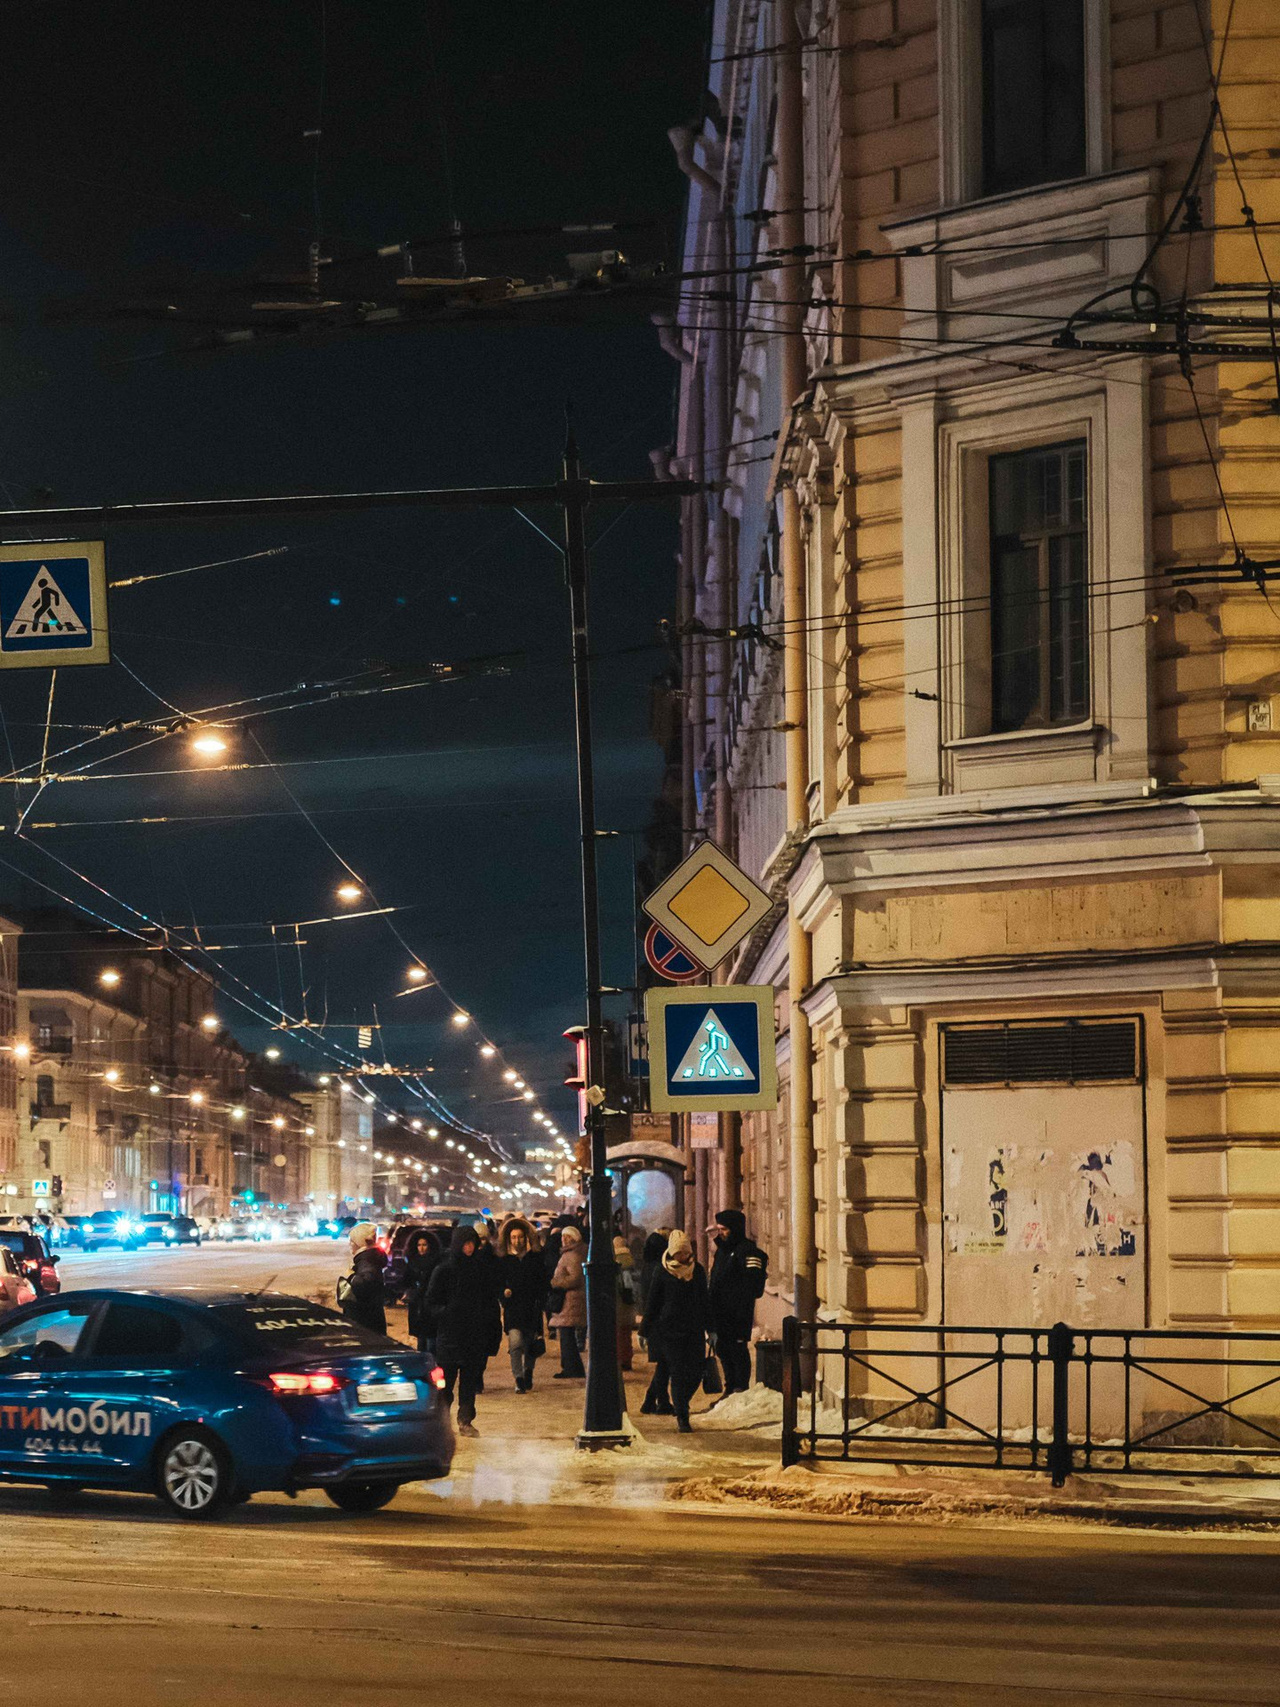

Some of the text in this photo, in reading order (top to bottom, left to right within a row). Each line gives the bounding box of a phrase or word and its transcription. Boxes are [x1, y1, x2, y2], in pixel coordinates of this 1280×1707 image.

[24, 1437, 103, 1454] 404 44 44
